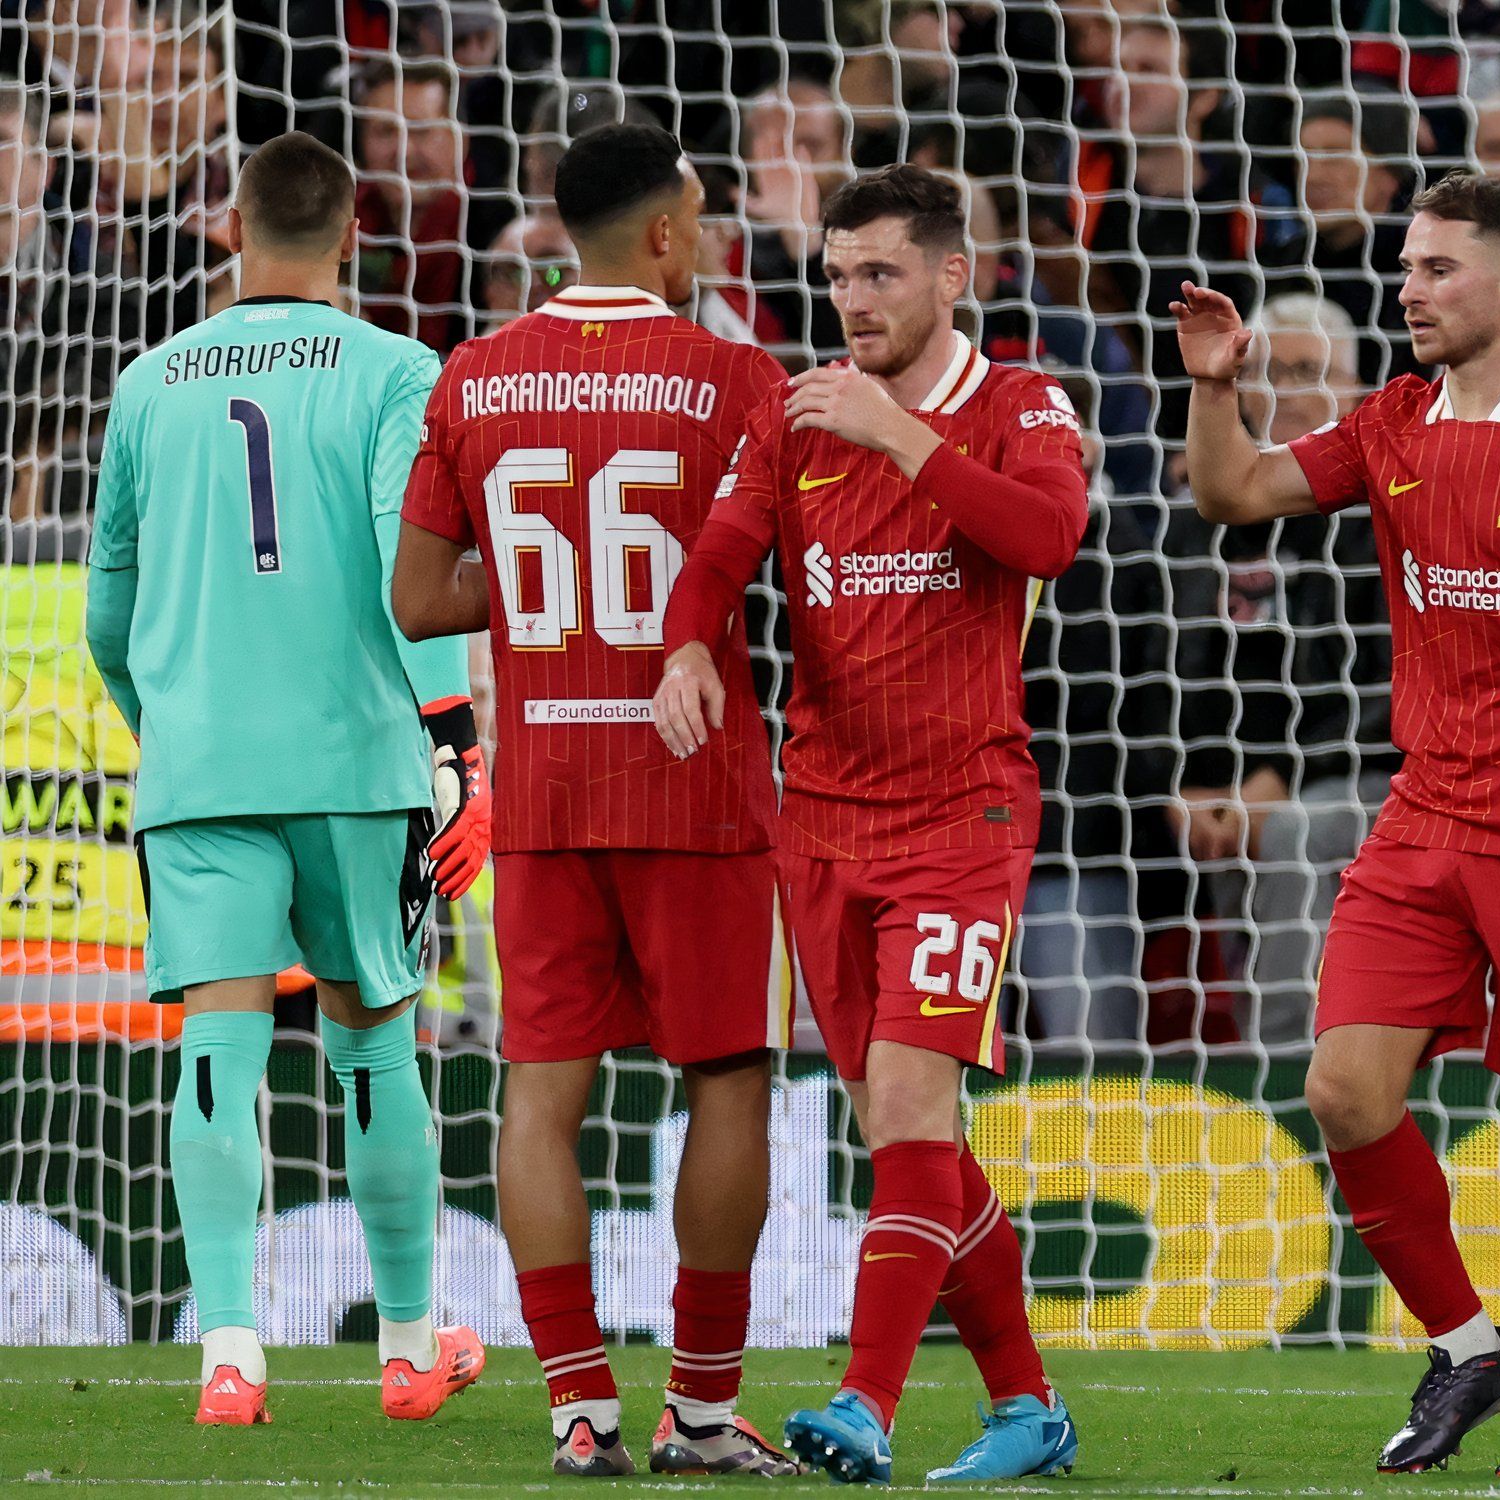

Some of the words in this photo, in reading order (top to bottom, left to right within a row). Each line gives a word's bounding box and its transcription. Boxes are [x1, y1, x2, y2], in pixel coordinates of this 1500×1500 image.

[165, 336, 341, 386] SKORUPSKI
[228, 397, 281, 574] 1
[483, 448, 686, 652] 66
[840, 548, 953, 575] standard
[840, 568, 961, 596] chartered
[547, 703, 650, 718] Foundation
[910, 912, 1001, 1004] 26
[555, 1389, 582, 1405] LFC
